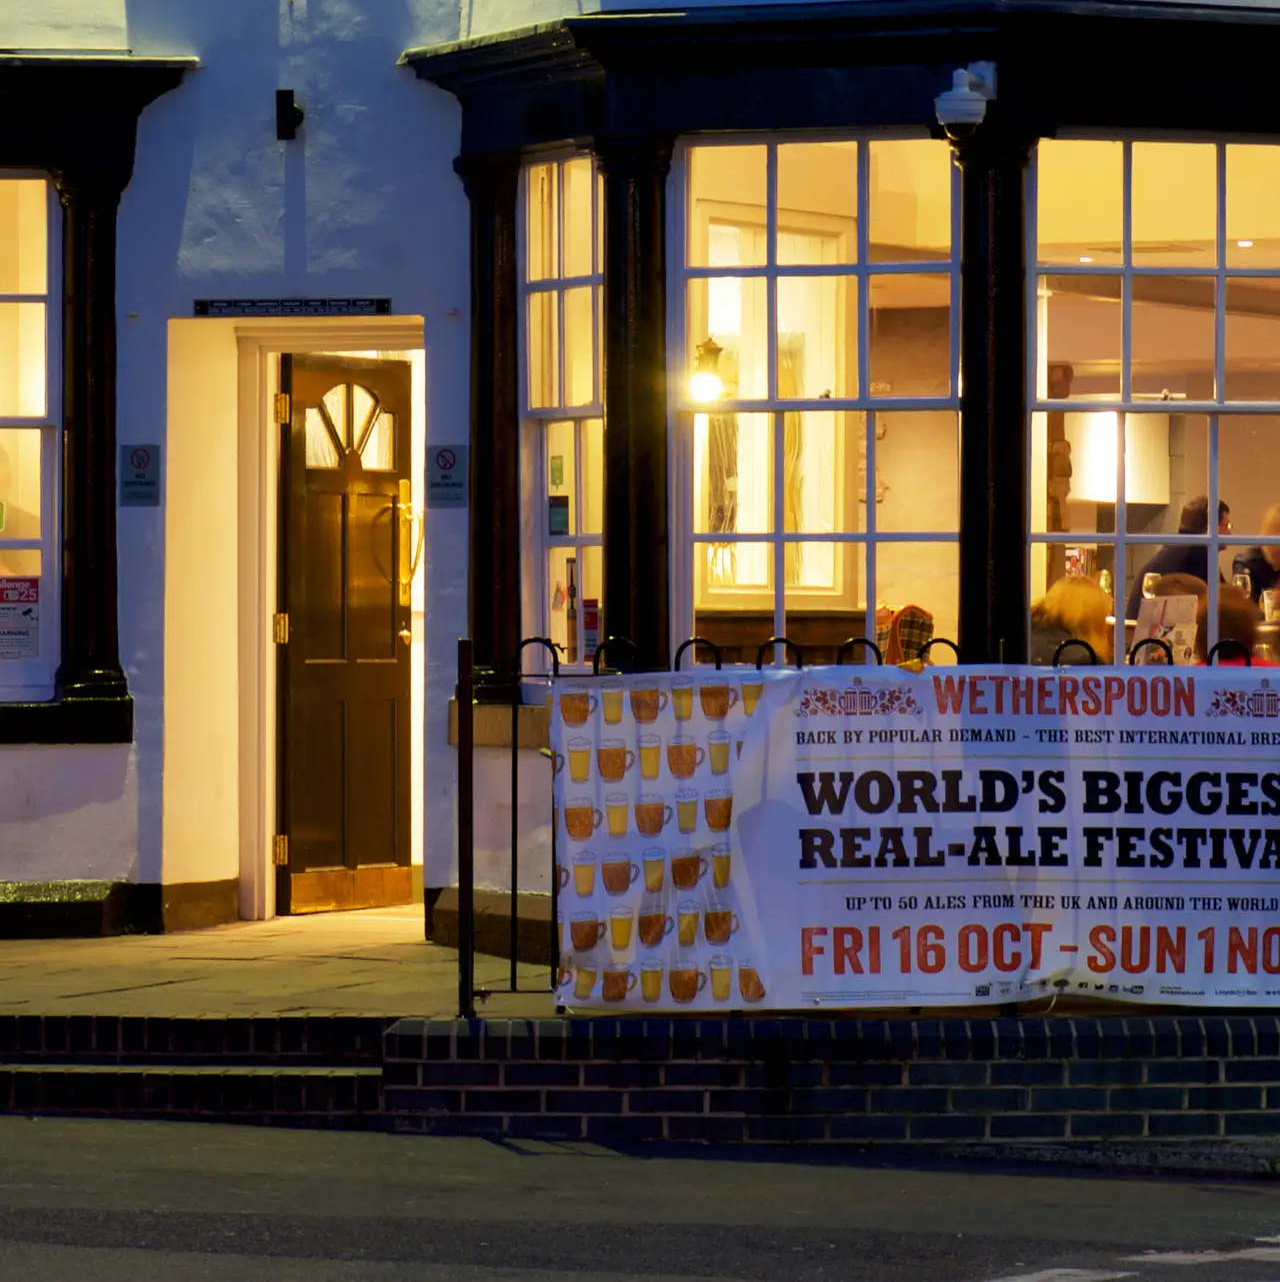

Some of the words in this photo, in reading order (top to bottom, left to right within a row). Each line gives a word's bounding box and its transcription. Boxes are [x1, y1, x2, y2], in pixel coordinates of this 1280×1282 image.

[19, 588, 38, 601] 25
[932, 674, 1195, 716] WETHERSPOON
[796, 730, 837, 746] BACK
[843, 730, 863, 744] BY
[868, 729, 943, 744] POPULAR
[949, 728, 1017, 743] DEMAND
[1035, 728, 1068, 744] THE
[1074, 729, 1114, 743] BEST
[1119, 729, 1246, 746] INTERNATIONAL
[796, 769, 1067, 815] WORLD'S
[799, 826, 1068, 869] REAL-ALE
[846, 896, 866, 911] UP
[870, 896, 892, 910] TO
[898, 896, 918, 909] 50
[924, 895, 966, 909] ALES
[972, 895, 1015, 908] FROM
[1020, 894, 1055, 909] THE
[1061, 895, 1081, 910] UK
[1087, 896, 1118, 910] AND
[1123, 896, 1185, 910] AROUND
[1189, 897, 1222, 911] THE
[1227, 897, 1279, 911] WORLD
[801, 926, 881, 975] FRI
[892, 924, 946, 974] 16
[957, 923, 1053, 973] OCT
[1086, 924, 1187, 974] SUN
[1197, 926, 1215, 973] 1
